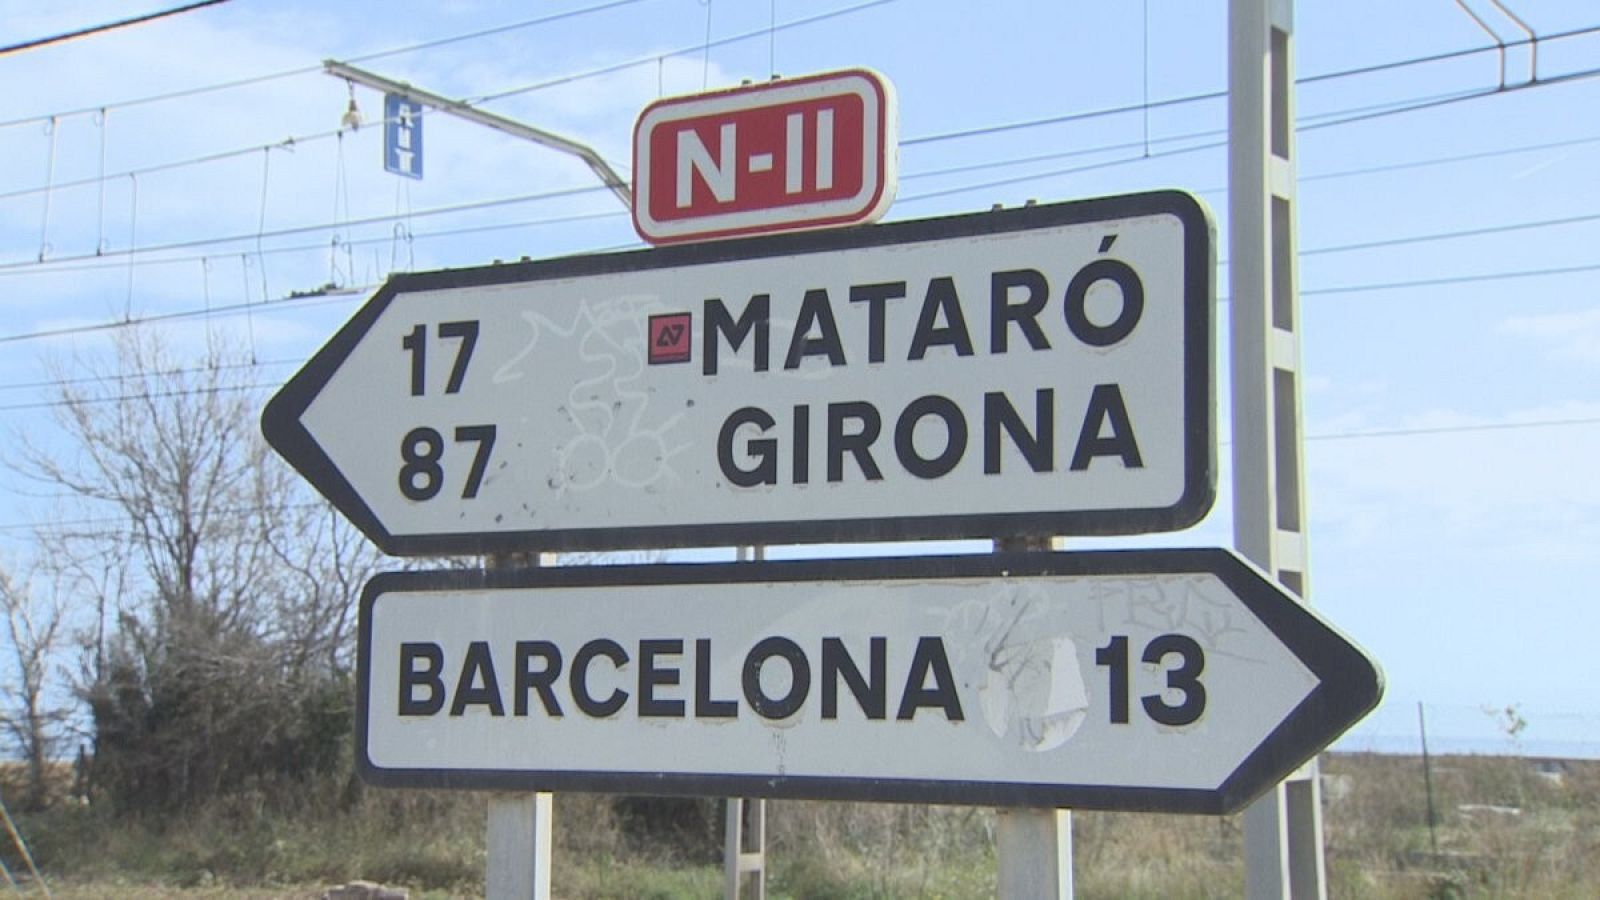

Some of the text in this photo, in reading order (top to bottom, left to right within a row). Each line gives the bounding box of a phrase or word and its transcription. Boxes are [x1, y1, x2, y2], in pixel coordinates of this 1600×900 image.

[702, 235, 1145, 377] MATARÓ
[402, 320, 480, 397] 17
[399, 424, 497, 502] 87
[716, 384, 1144, 488] GIRONA
[397, 636, 965, 722] BARCELONA
[1095, 634, 1207, 727] 13
